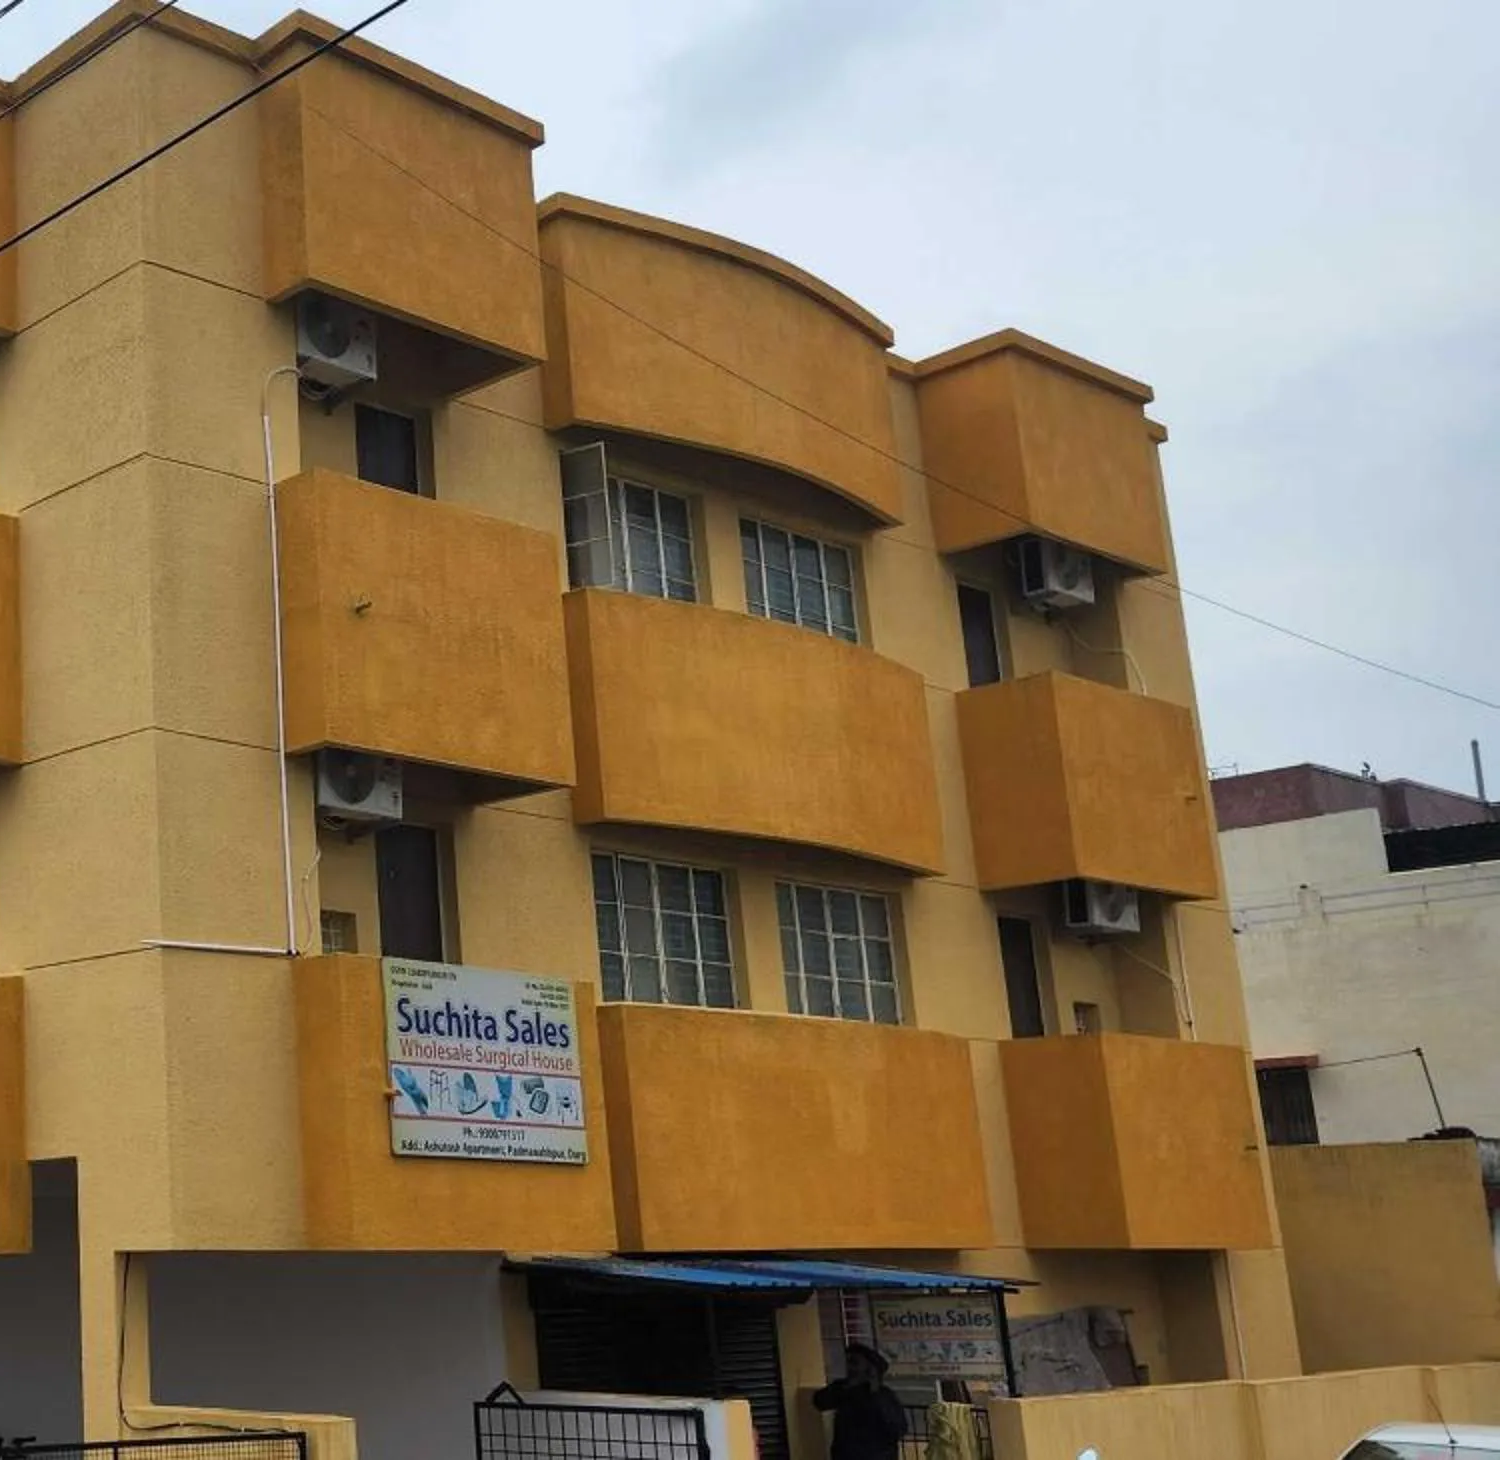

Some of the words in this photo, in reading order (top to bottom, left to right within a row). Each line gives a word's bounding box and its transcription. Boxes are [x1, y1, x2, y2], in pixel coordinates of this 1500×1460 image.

[397, 997, 498, 1041] Suchita
[505, 1009, 569, 1048] Sales
[400, 1039, 472, 1063] Wholesale
[476, 1046, 529, 1071] Surgical
[531, 1054, 573, 1071] House
[878, 1310, 942, 1328] Suchita
[946, 1309, 993, 1327] Sales
